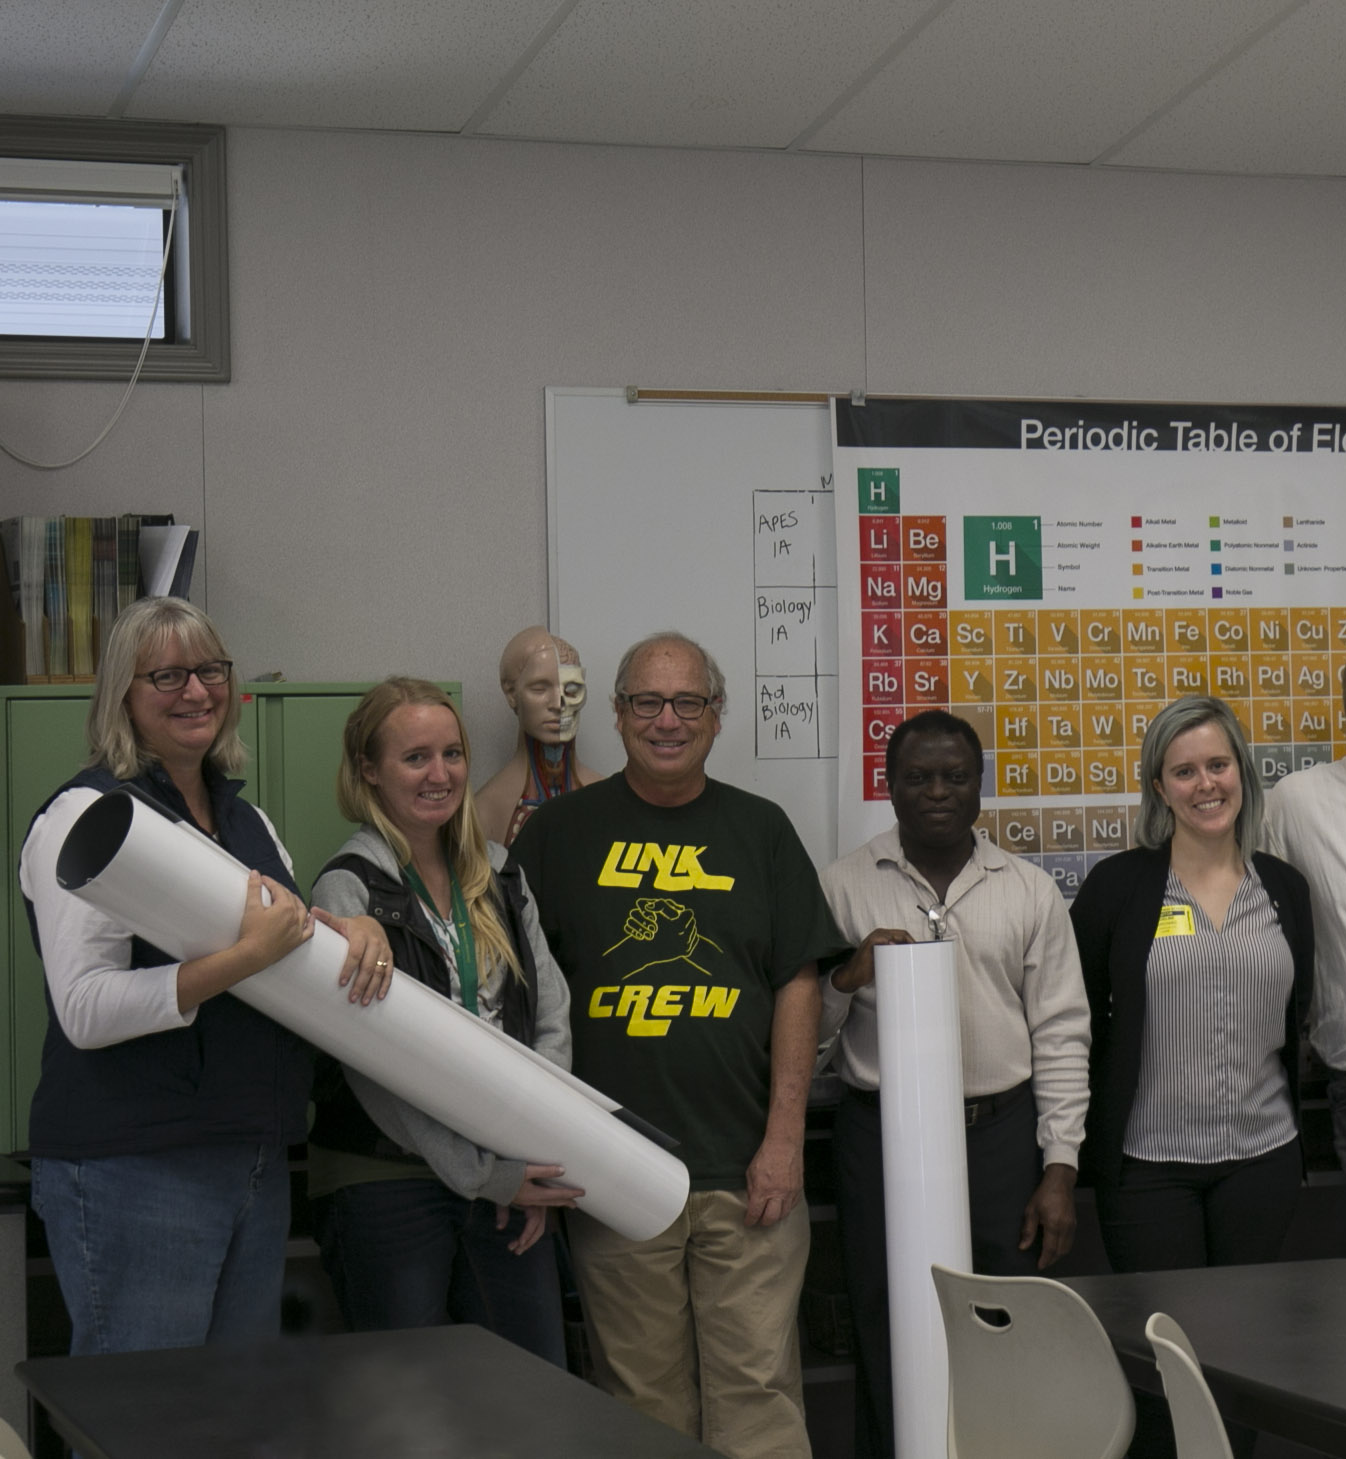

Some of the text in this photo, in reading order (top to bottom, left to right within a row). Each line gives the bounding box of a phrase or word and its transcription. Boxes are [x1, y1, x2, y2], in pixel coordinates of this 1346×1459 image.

[1020, 418, 1159, 451] Periodic
[1169, 421, 1259, 452] Table
[1268, 423, 1302, 453] of
[870, 481, 886, 501] H
[758, 510, 799, 533] APES
[991, 522, 1012, 530] 1.008
[1032, 519, 1038, 531] 1
[870, 529, 888, 549] Li
[909, 529, 940, 549] Be
[1080, 542, 1100, 550] Weight
[893, 564, 900, 572] 11
[938, 564, 946, 572] 12
[990, 540, 1016, 576] H
[1058, 564, 1081, 572] Symbol
[867, 576, 896, 597] Na
[907, 576, 942, 600] Mg
[983, 584, 1022, 595] Hydrogen
[757, 595, 813, 624] Biology
[873, 624, 888, 644] K
[910, 624, 941, 644] Ca
[956, 622, 985, 644] Sc
[1004, 622, 1024, 643] Ti
[1050, 622, 1066, 642] V
[1087, 622, 1112, 642] Cr
[1128, 622, 1160, 642] Mn
[1174, 620, 1200, 640] Fe
[1214, 620, 1244, 640] Co
[1260, 620, 1280, 640] Ni
[1296, 620, 1324, 640] Cu
[868, 672, 898, 692] Rb
[914, 671, 940, 692] Sr
[963, 670, 980, 691] Y
[1003, 670, 1027, 690] Zr
[1044, 670, 1074, 690] Nb
[1086, 668, 1118, 689] Mo
[1132, 668, 1157, 688] Tc
[1173, 666, 1201, 687] Ru
[1217, 666, 1244, 686] Rh
[1258, 666, 1285, 686] Pd
[1298, 666, 1325, 690] Ag
[760, 684, 785, 704] Ad
[761, 701, 814, 724] Biology
[977, 706, 994, 714] 57-71
[868, 720, 894, 741] Cs
[1004, 718, 1028, 738] Hf
[1048, 716, 1072, 737] Ta
[1092, 716, 1114, 735] W
[1262, 712, 1284, 731] Pt
[1300, 711, 1326, 730] Au
[1006, 764, 1029, 785] Rf
[1047, 763, 1076, 784] Db
[1090, 762, 1117, 786] Sg
[1262, 758, 1288, 777] Ds
[1006, 821, 1035, 842] Ce
[1052, 820, 1076, 840] Pr
[1092, 818, 1122, 839] Nd
[597, 841, 735, 892] LINK
[1051, 868, 1080, 887] Pa
[588, 984, 741, 1037] CREW
